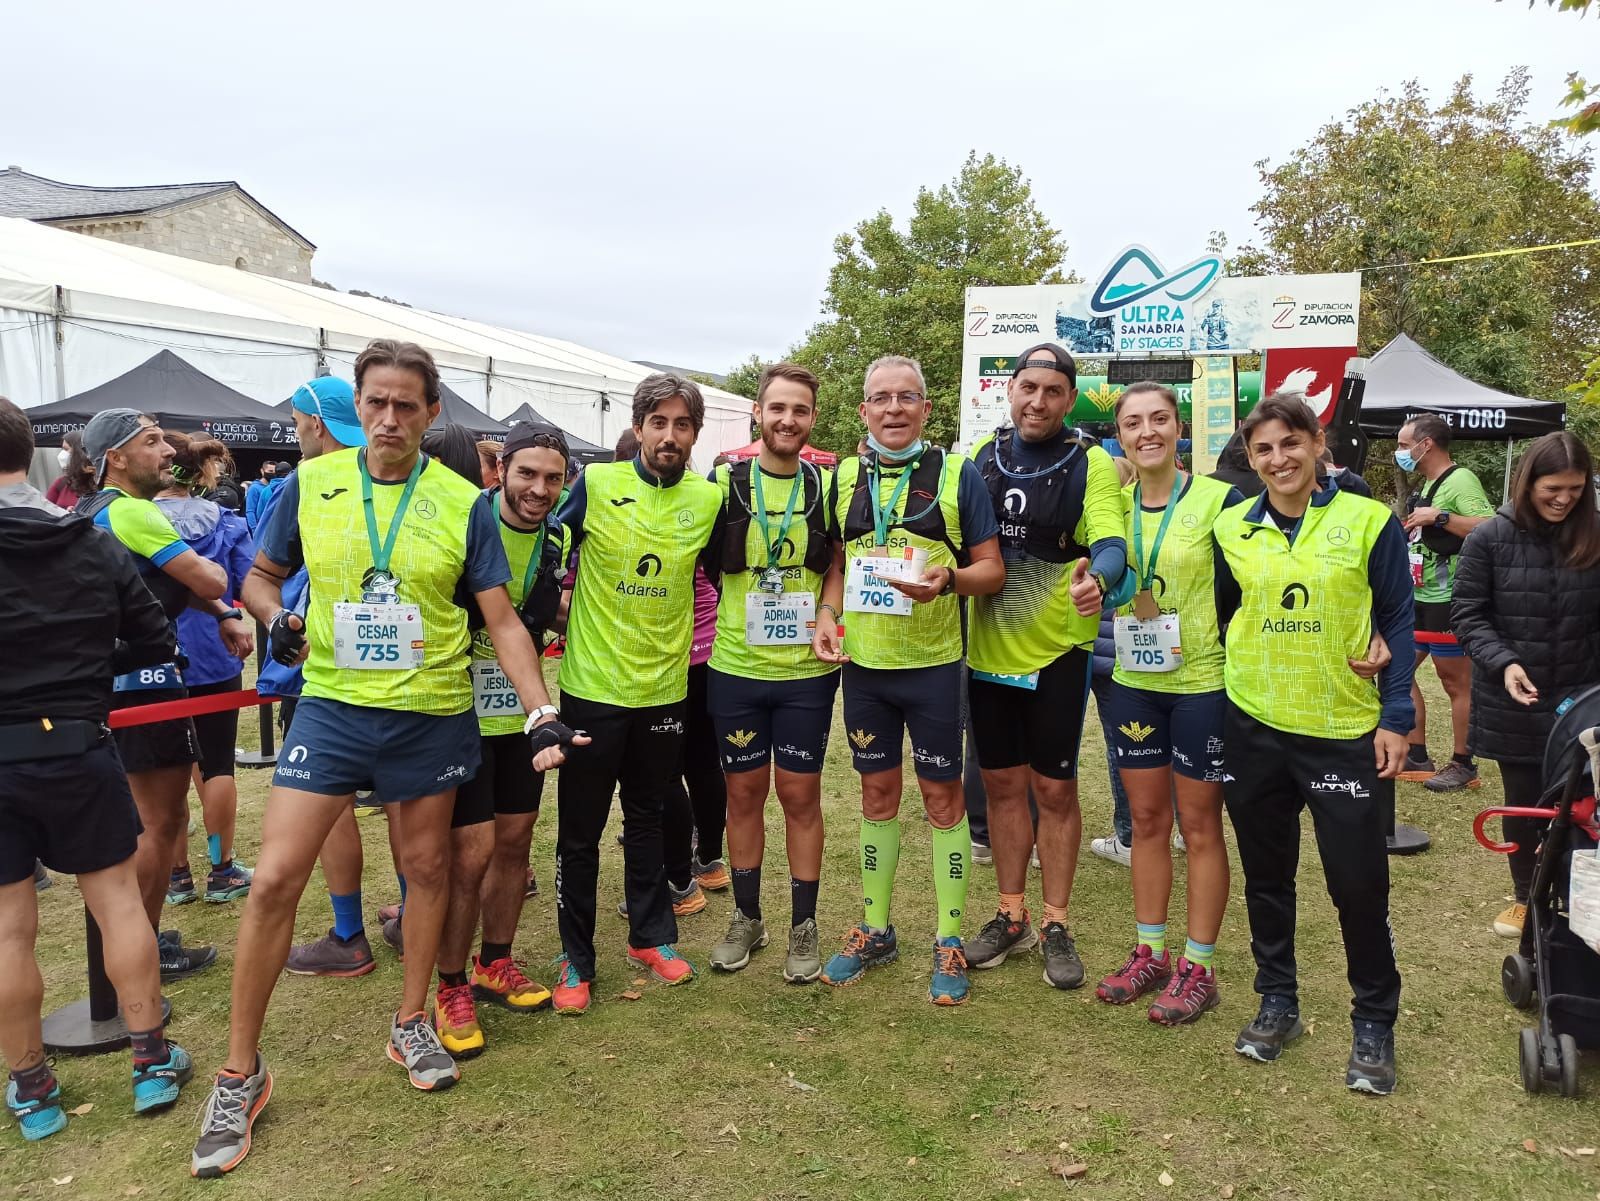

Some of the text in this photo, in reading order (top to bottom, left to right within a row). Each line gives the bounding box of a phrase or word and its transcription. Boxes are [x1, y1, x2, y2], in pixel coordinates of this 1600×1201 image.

[1121, 305, 1184, 322] ULTRA
[1299, 315, 1355, 326] ZAMORA
[991, 324, 1040, 334] ZAMORA
[1121, 323, 1184, 334] SANABRIA
[1120, 336, 1183, 349] BY STAGES
[1458, 408, 1506, 429] TORO
[999, 521, 1027, 538] dars
[855, 535, 908, 549] Adrsa
[616, 580, 667, 598] Adarsa
[860, 590, 894, 608] 706
[764, 609, 798, 622] ADRIAN
[357, 624, 398, 640] CESAR
[763, 624, 798, 639] 785
[1261, 617, 1321, 633] Adarsa
[1133, 633, 1158, 647] ELENI
[356, 643, 400, 662] 735
[1131, 649, 1165, 665] 705
[140, 668, 166, 684] 86
[480, 692, 518, 709] 738
[736, 749, 766, 762] AQUONA
[1127, 747, 1163, 756] AQUONA
[276, 766, 311, 780] Adarsa
